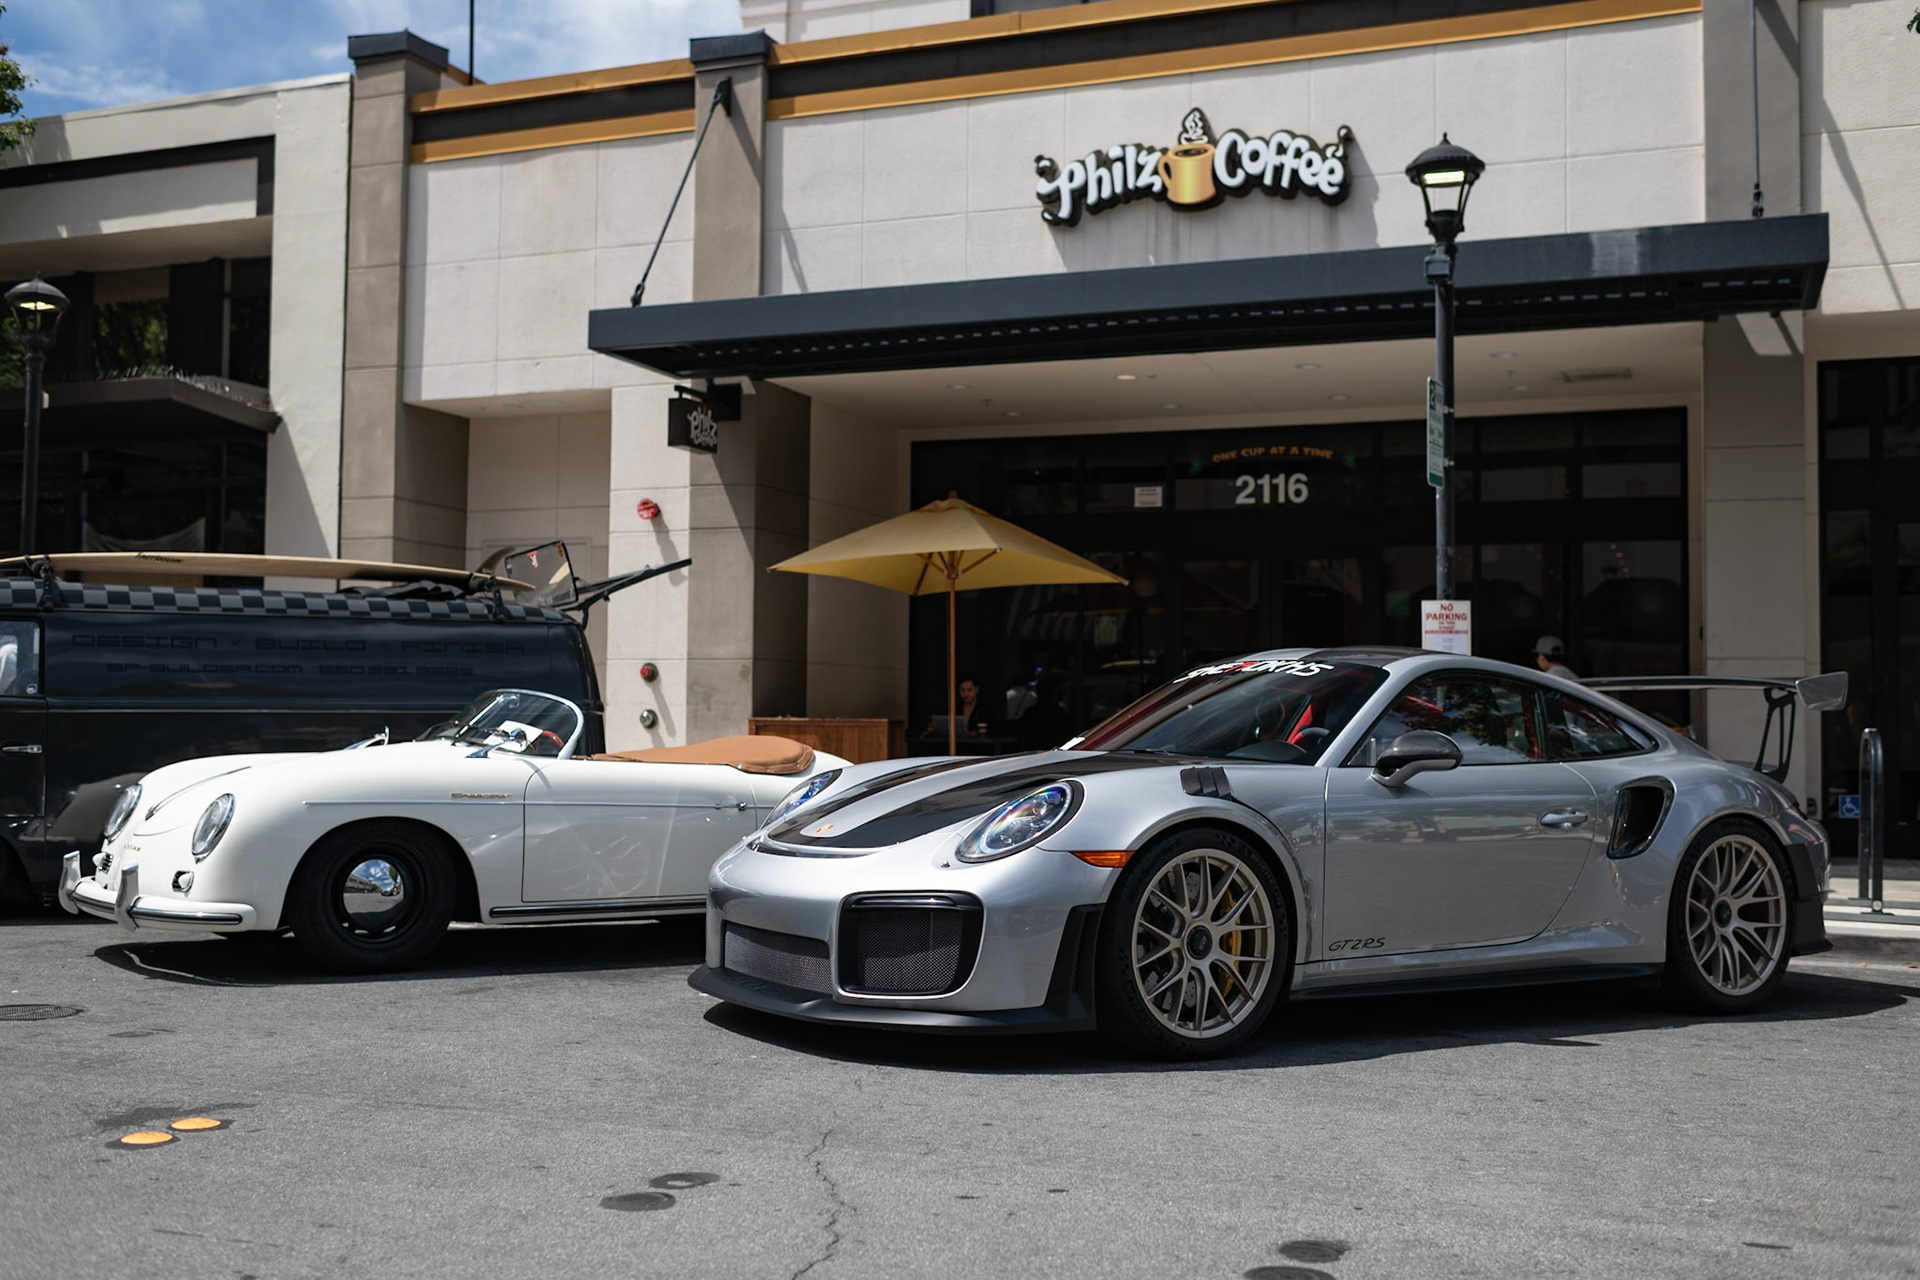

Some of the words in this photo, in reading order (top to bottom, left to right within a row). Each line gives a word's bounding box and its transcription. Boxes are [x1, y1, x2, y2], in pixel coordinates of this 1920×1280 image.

[1035, 144, 1164, 222] Philz
[1212, 451, 1237, 463] ONE
[1241, 447, 1265, 457] CUP
[1269, 446, 1286, 455] AT
[1290, 446, 1299, 455] A
[1302, 447, 1334, 459] TIME
[1235, 473, 1309, 504] 2116
[1440, 603, 1453, 611] NO
[1426, 613, 1467, 621] PARKING
[72, 634, 217, 649] DESIGN
[255, 638, 366, 651] BUILD
[401, 640, 525, 654] FINISH
